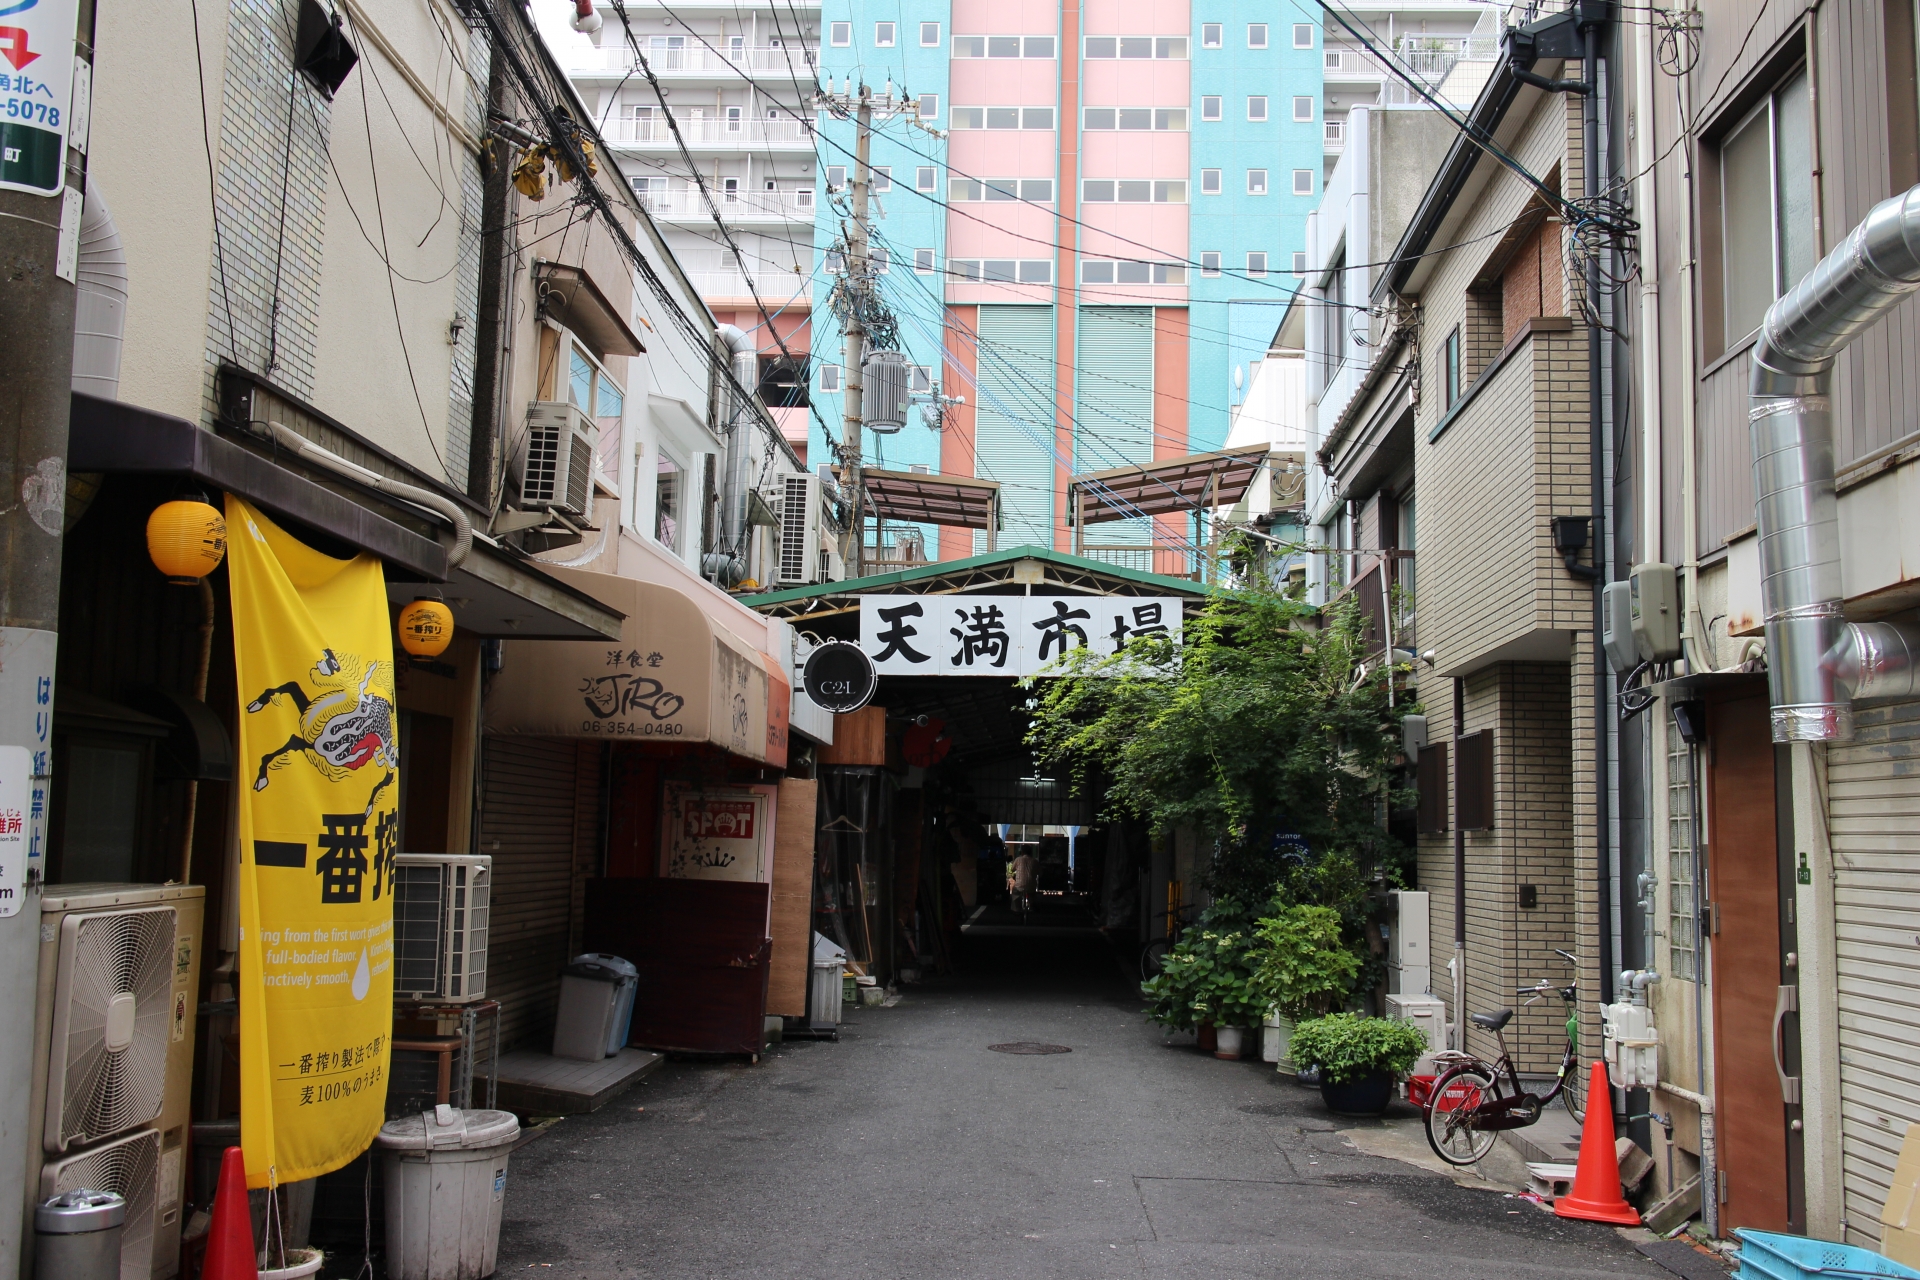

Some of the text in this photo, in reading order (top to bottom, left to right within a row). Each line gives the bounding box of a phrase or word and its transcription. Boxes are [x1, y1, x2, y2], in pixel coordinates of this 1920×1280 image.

[4, 147, 22, 163] 町
[406, 624, 442, 635] 一番搾り
[871, 600, 1172, 668] 天満市場
[606, 649, 664, 669] 洋食堂
[584, 674, 685, 720] JIRO
[582, 721, 683, 735] 06-354-0480
[28, 676, 51, 858] はり紙禁止
[284, 928, 310, 942] from
[314, 929, 329, 942] the
[331, 928, 348, 942] first
[350, 929, 367, 941] wort
[367, 925, 380, 942] gives
[266, 950, 329, 964] full-bodied
[332, 949, 356, 963] flavor.
[315, 970, 350, 986] smooth,
